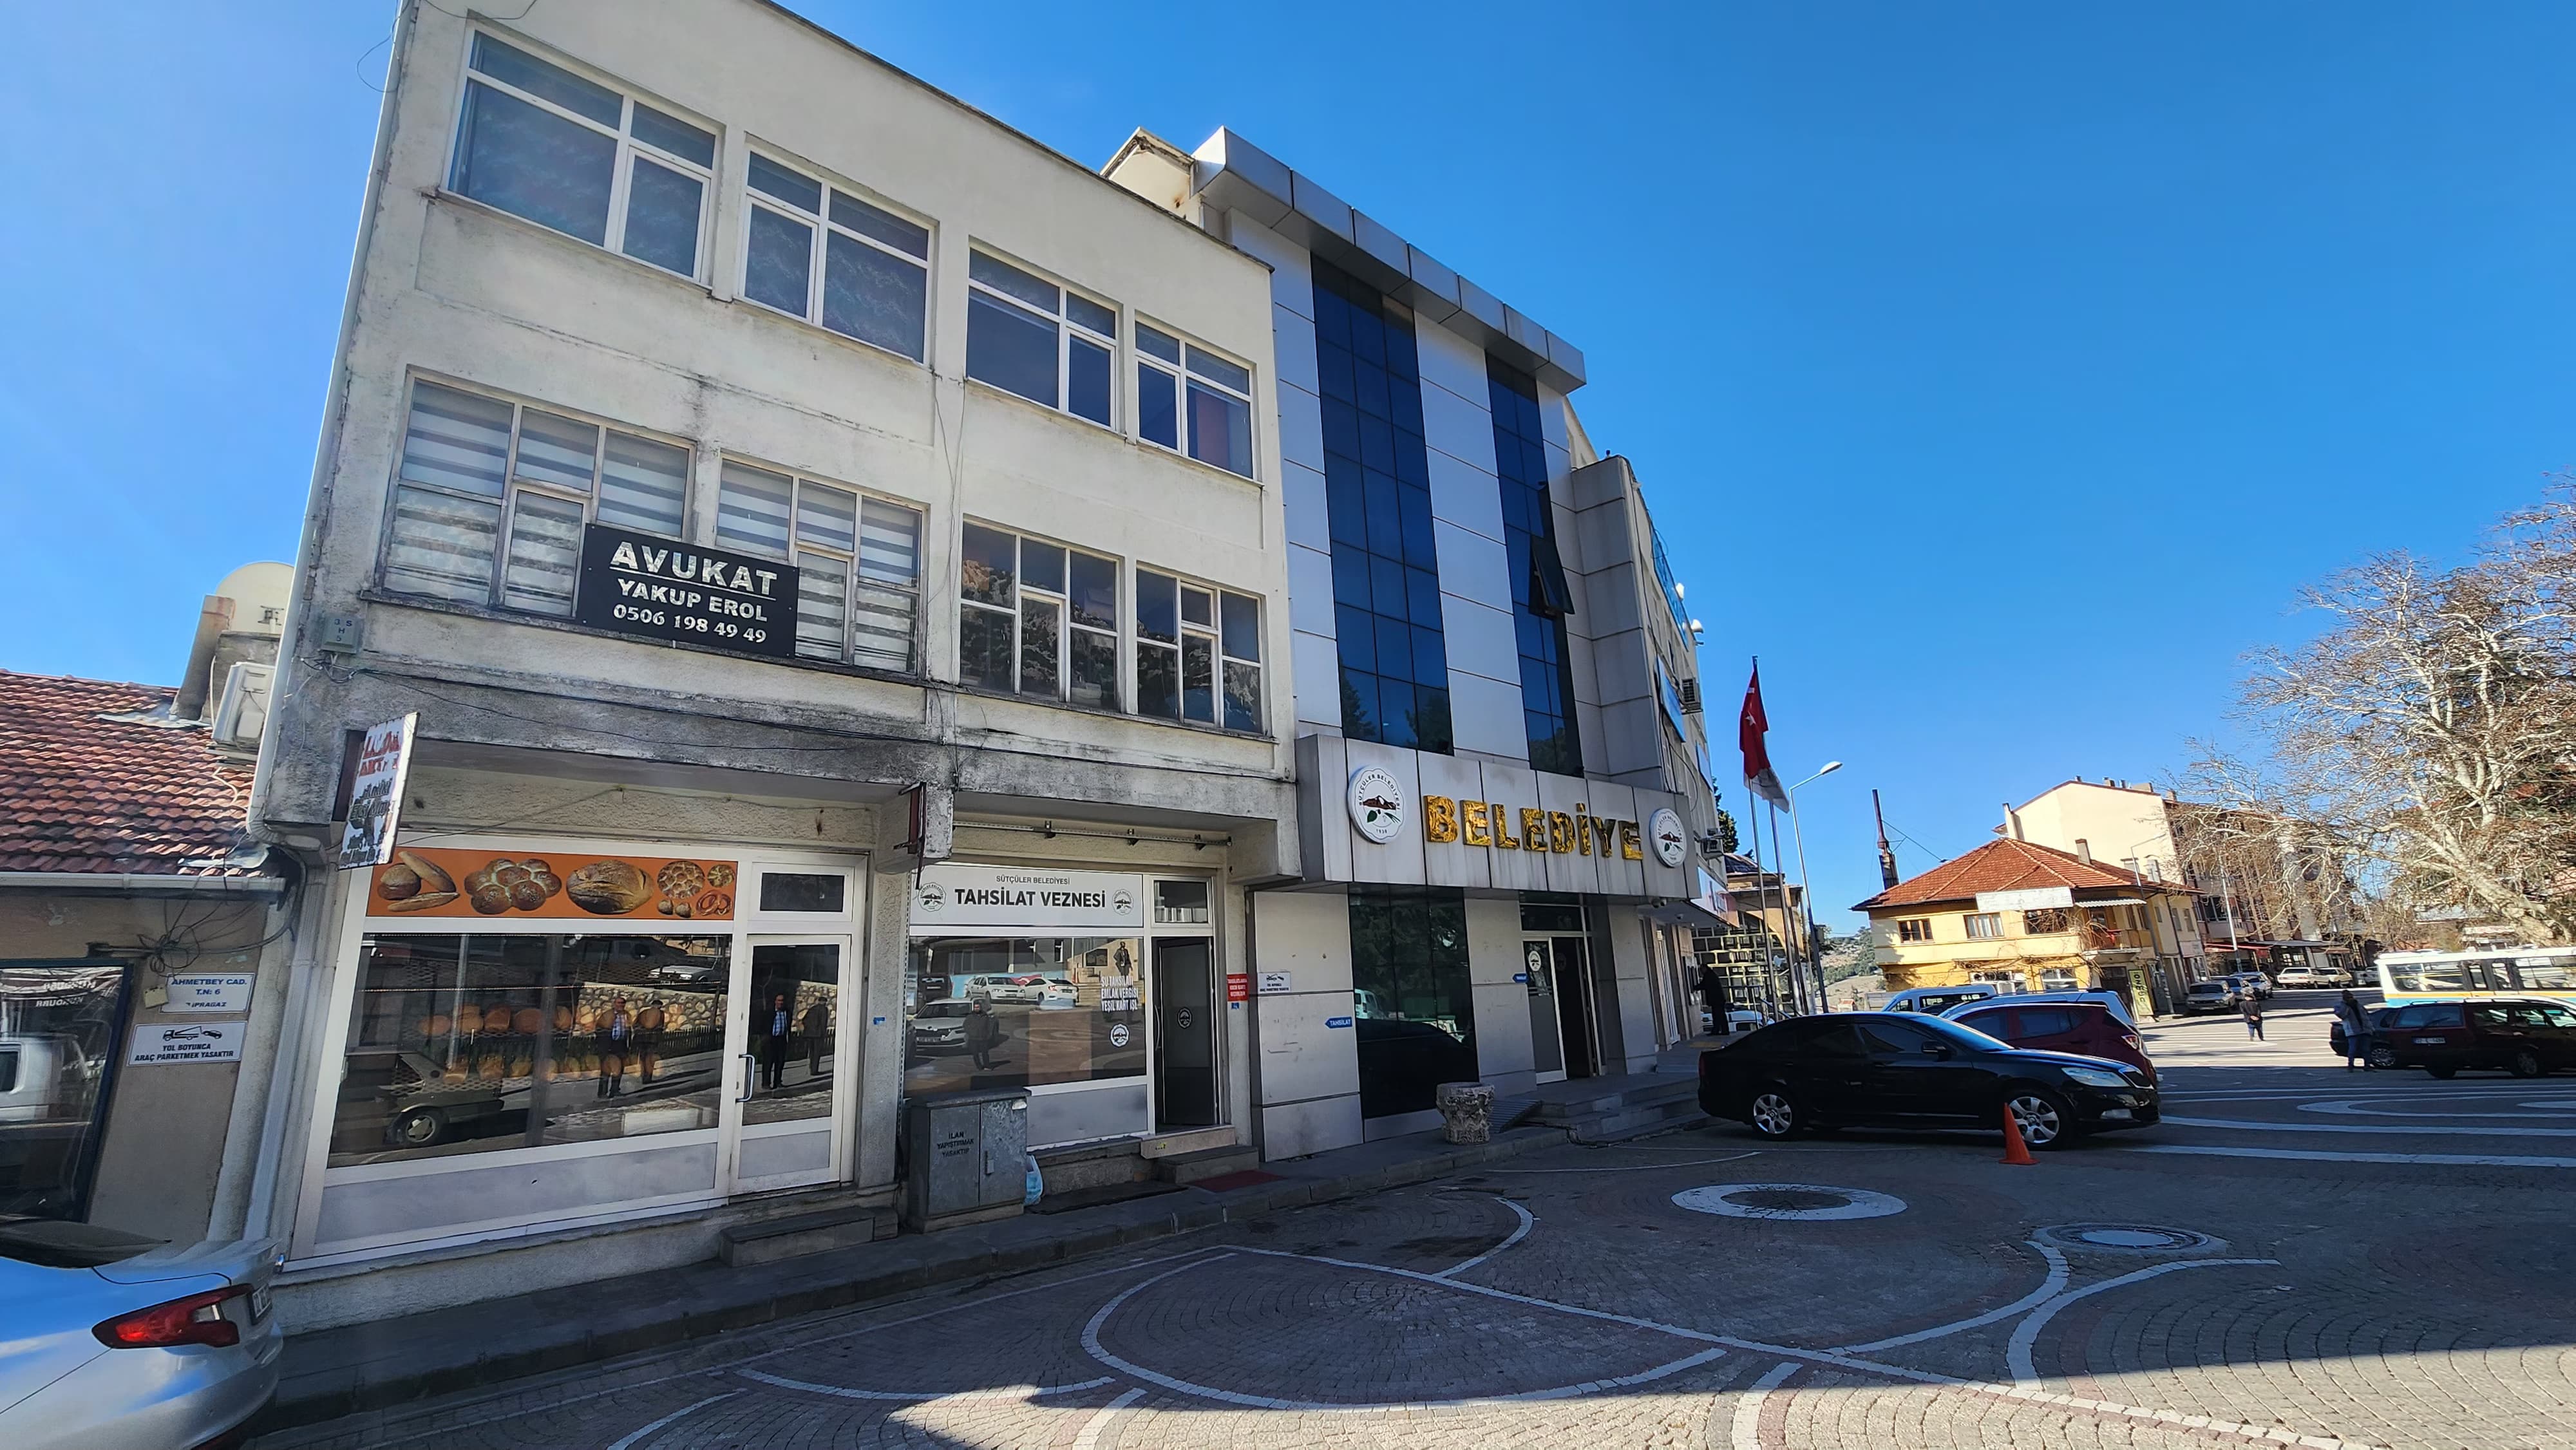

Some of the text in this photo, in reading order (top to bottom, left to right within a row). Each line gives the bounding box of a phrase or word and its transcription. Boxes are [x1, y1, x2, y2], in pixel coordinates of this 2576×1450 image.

[609, 541, 777, 595] AVUKAT
[618, 578, 768, 622] YAKUP EROL
[613, 604, 767, 643] 0506 198 49 49
[1423, 795, 1643, 860] BELEDİYE
[954, 887, 1036, 906] TAHSİLAT
[1040, 890, 1106, 908] VEZNESİ
[996, 875, 1031, 884] SÜTÇÜLER
[156, 1052, 200, 1060] PARKETMEK
